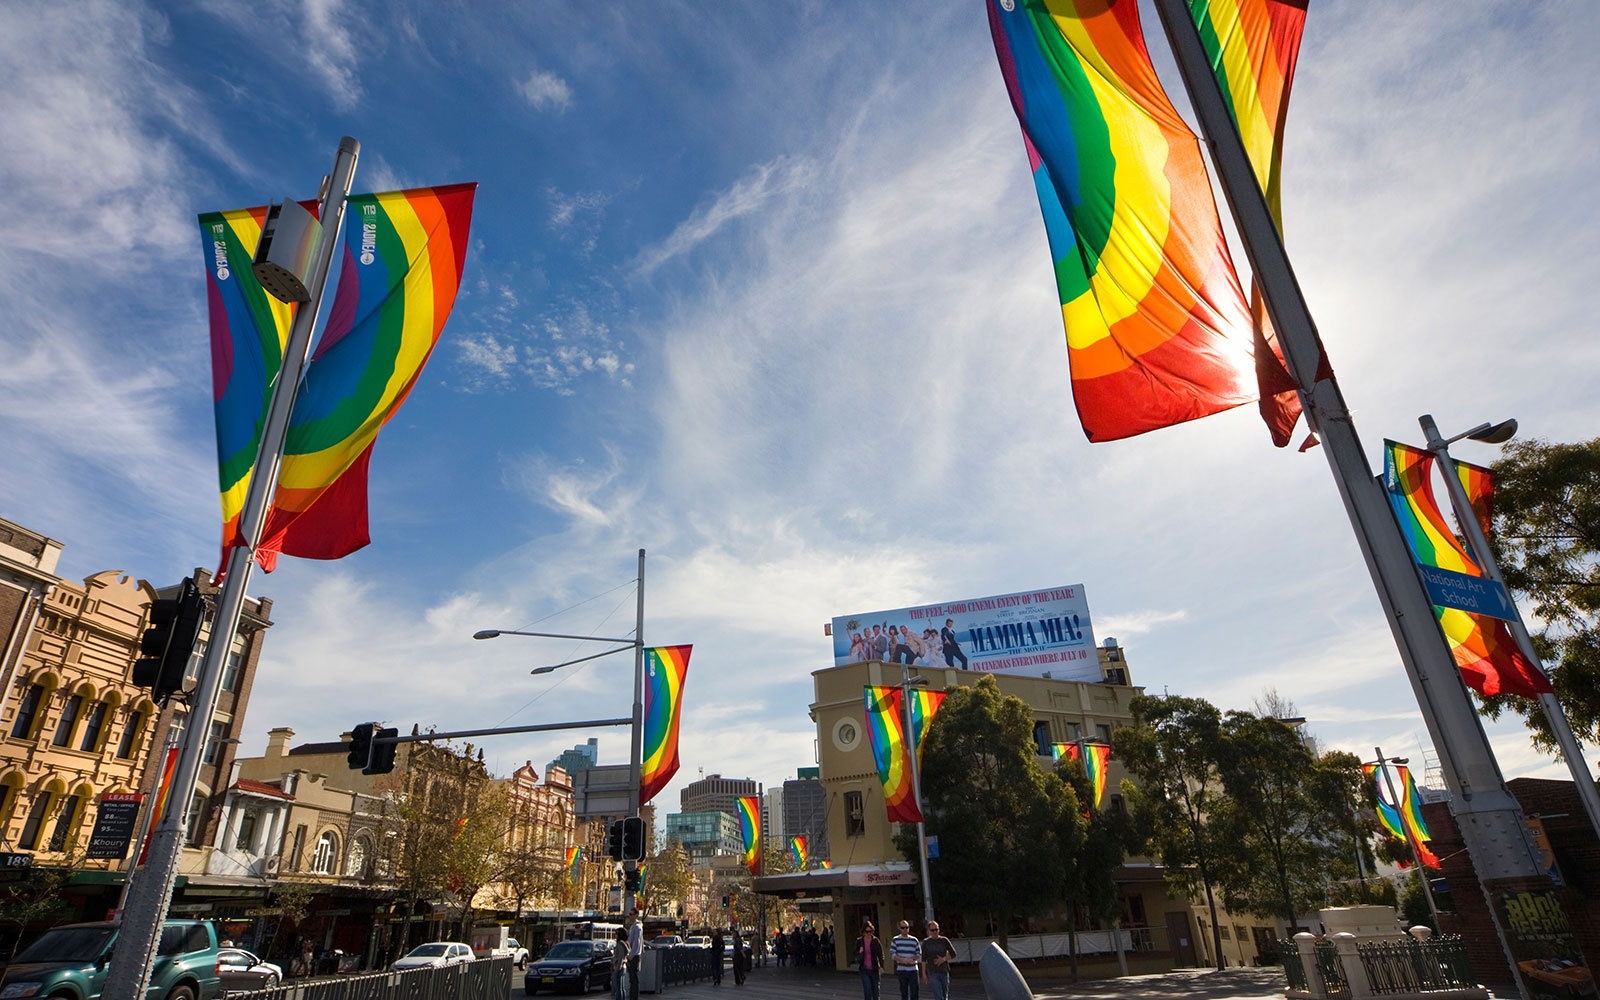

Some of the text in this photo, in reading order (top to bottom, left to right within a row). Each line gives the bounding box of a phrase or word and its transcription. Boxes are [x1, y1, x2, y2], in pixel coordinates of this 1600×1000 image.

[1423, 569, 1486, 594] National Art
[909, 588, 1075, 620] THE FEEL-GOOD CINEMA EVENT OF THE YEAR!
[1441, 588, 1479, 608] School
[968, 614, 1083, 653] MAMMA MIA!
[973, 649, 1087, 671] IN CINEMAS EVERYWHERE JULY 10
[93, 839, 125, 847] Khoury
[7, 855, 30, 866] 189
